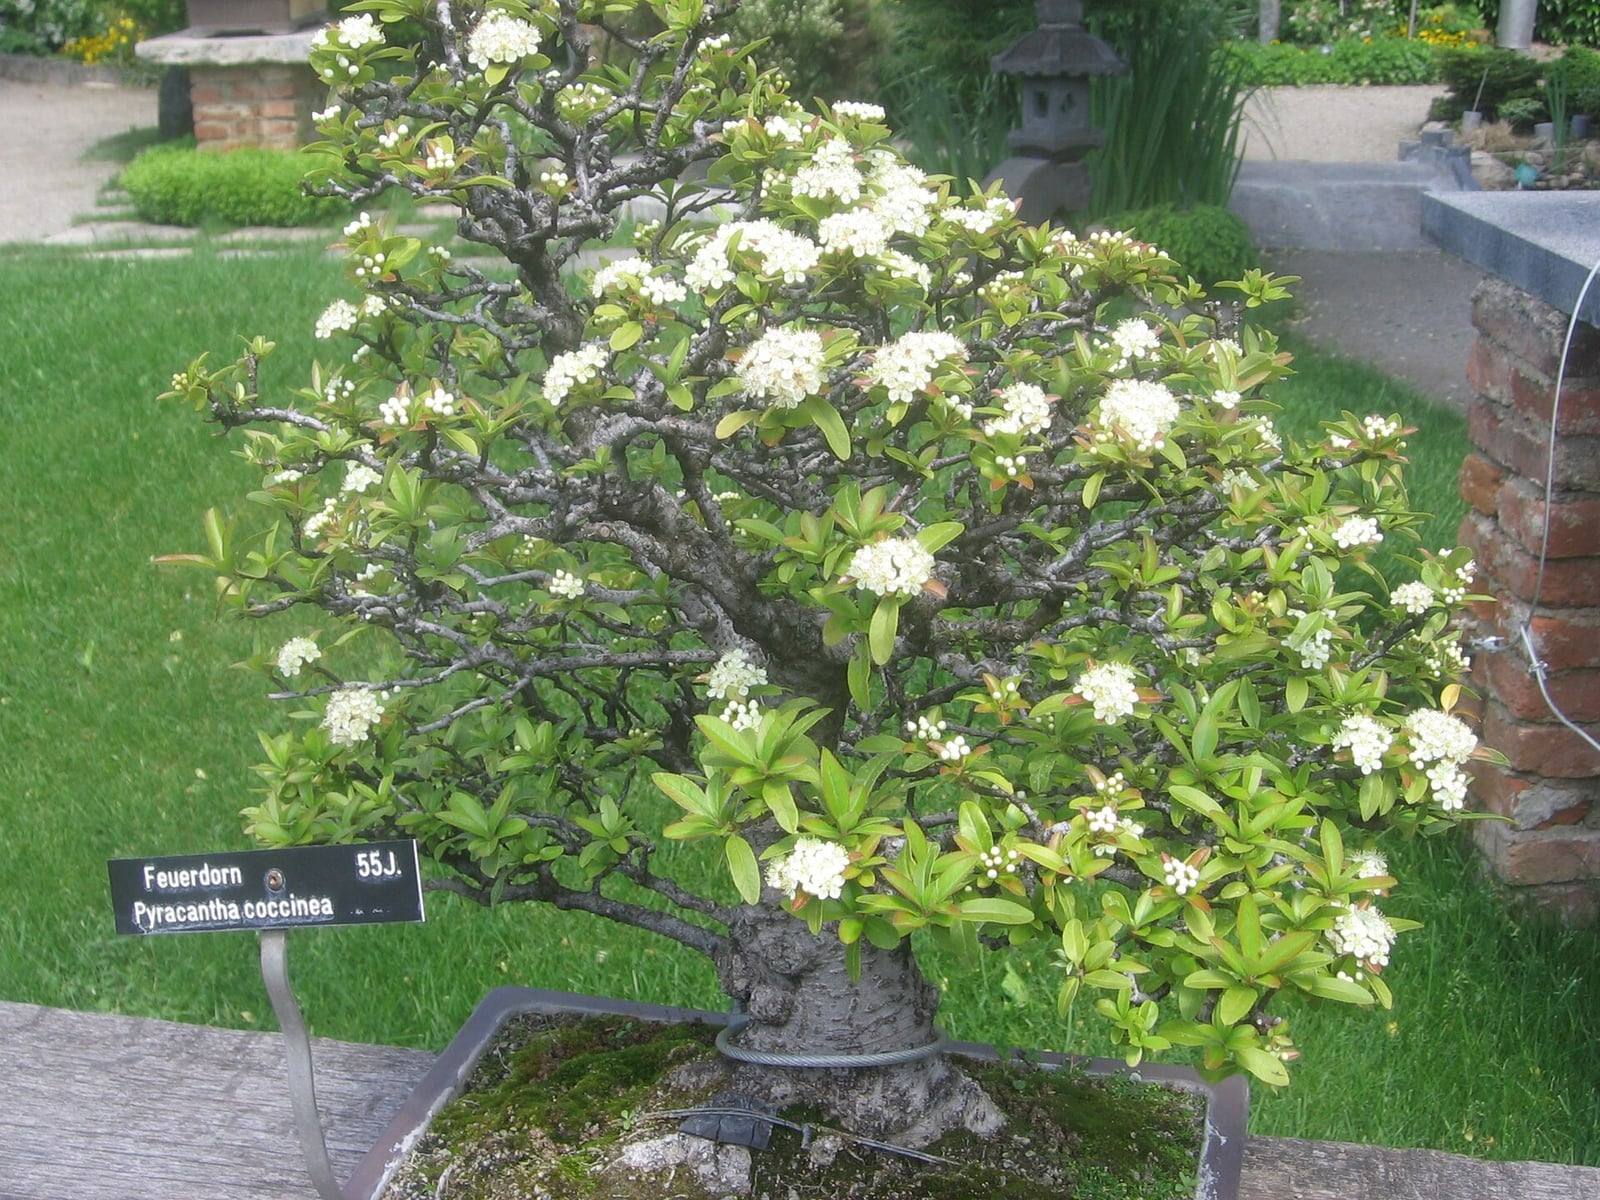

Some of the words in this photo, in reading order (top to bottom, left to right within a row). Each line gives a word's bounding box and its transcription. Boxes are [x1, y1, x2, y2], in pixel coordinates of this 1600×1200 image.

[143, 862, 242, 889] Feuerdorn
[357, 851, 402, 877] 55J.
[133, 897, 241, 930] Pyracantha
[243, 893, 334, 920] coccinea
